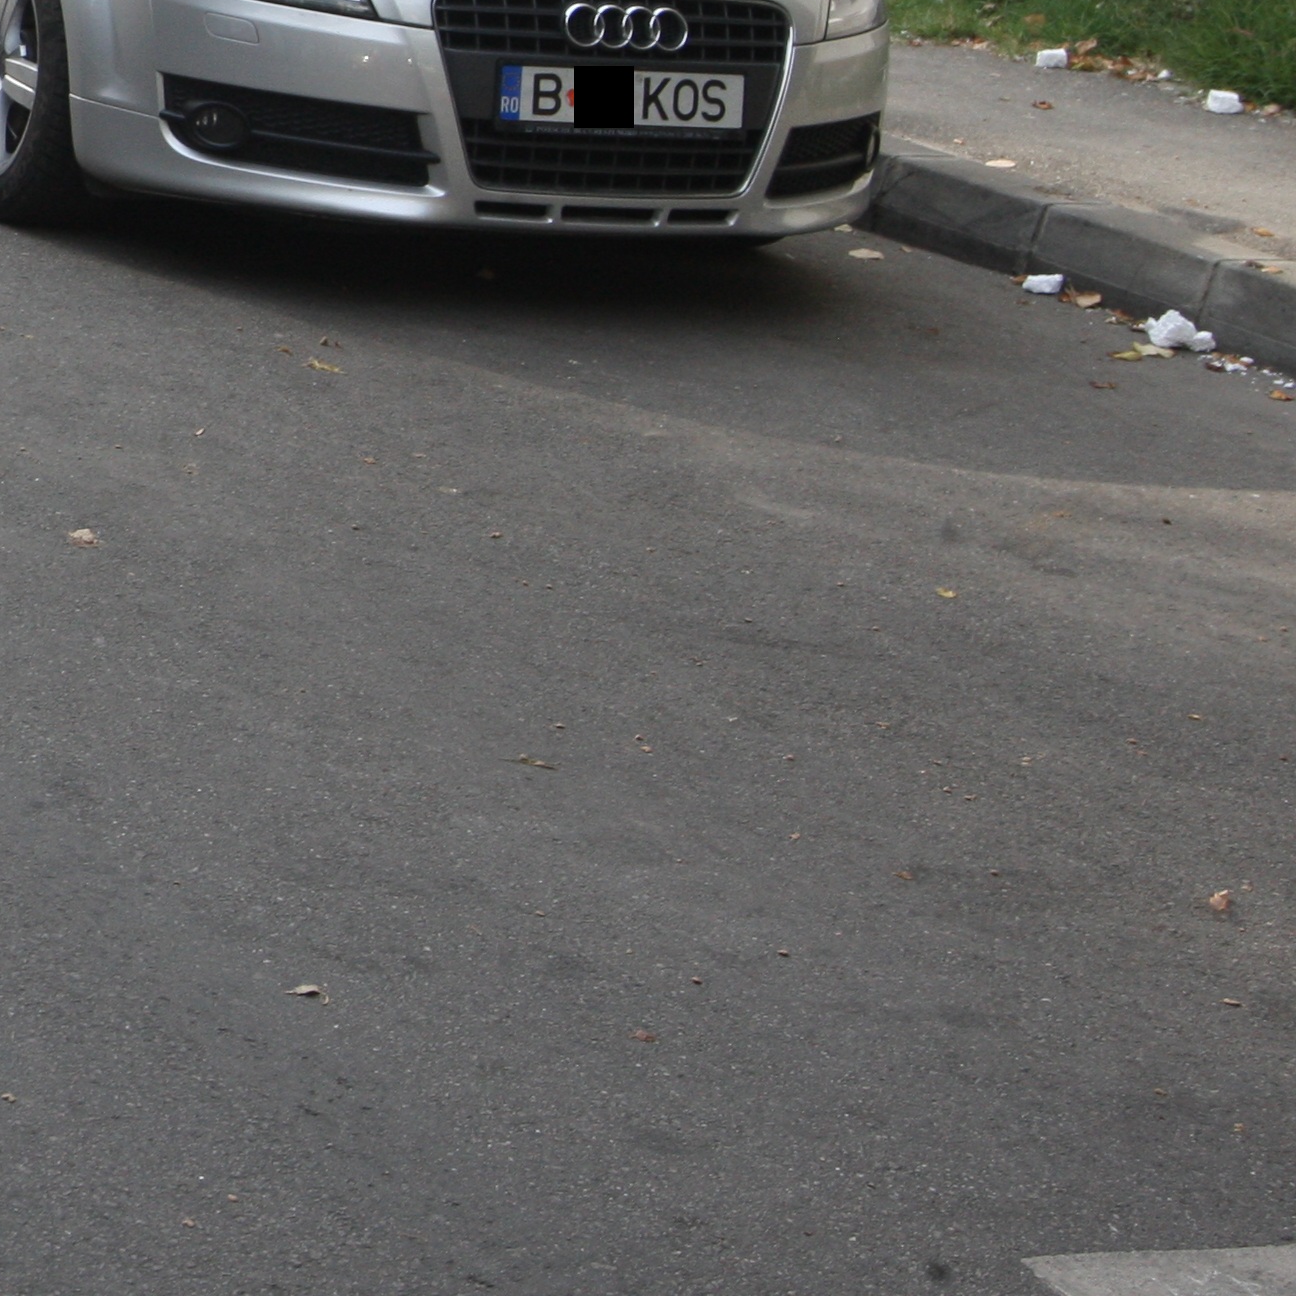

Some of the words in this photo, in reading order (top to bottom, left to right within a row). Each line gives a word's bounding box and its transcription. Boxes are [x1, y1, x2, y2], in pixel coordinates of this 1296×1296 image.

[500, 95, 519, 115] RO
[532, 73, 563, 116] B
[641, 77, 727, 122] KOS
